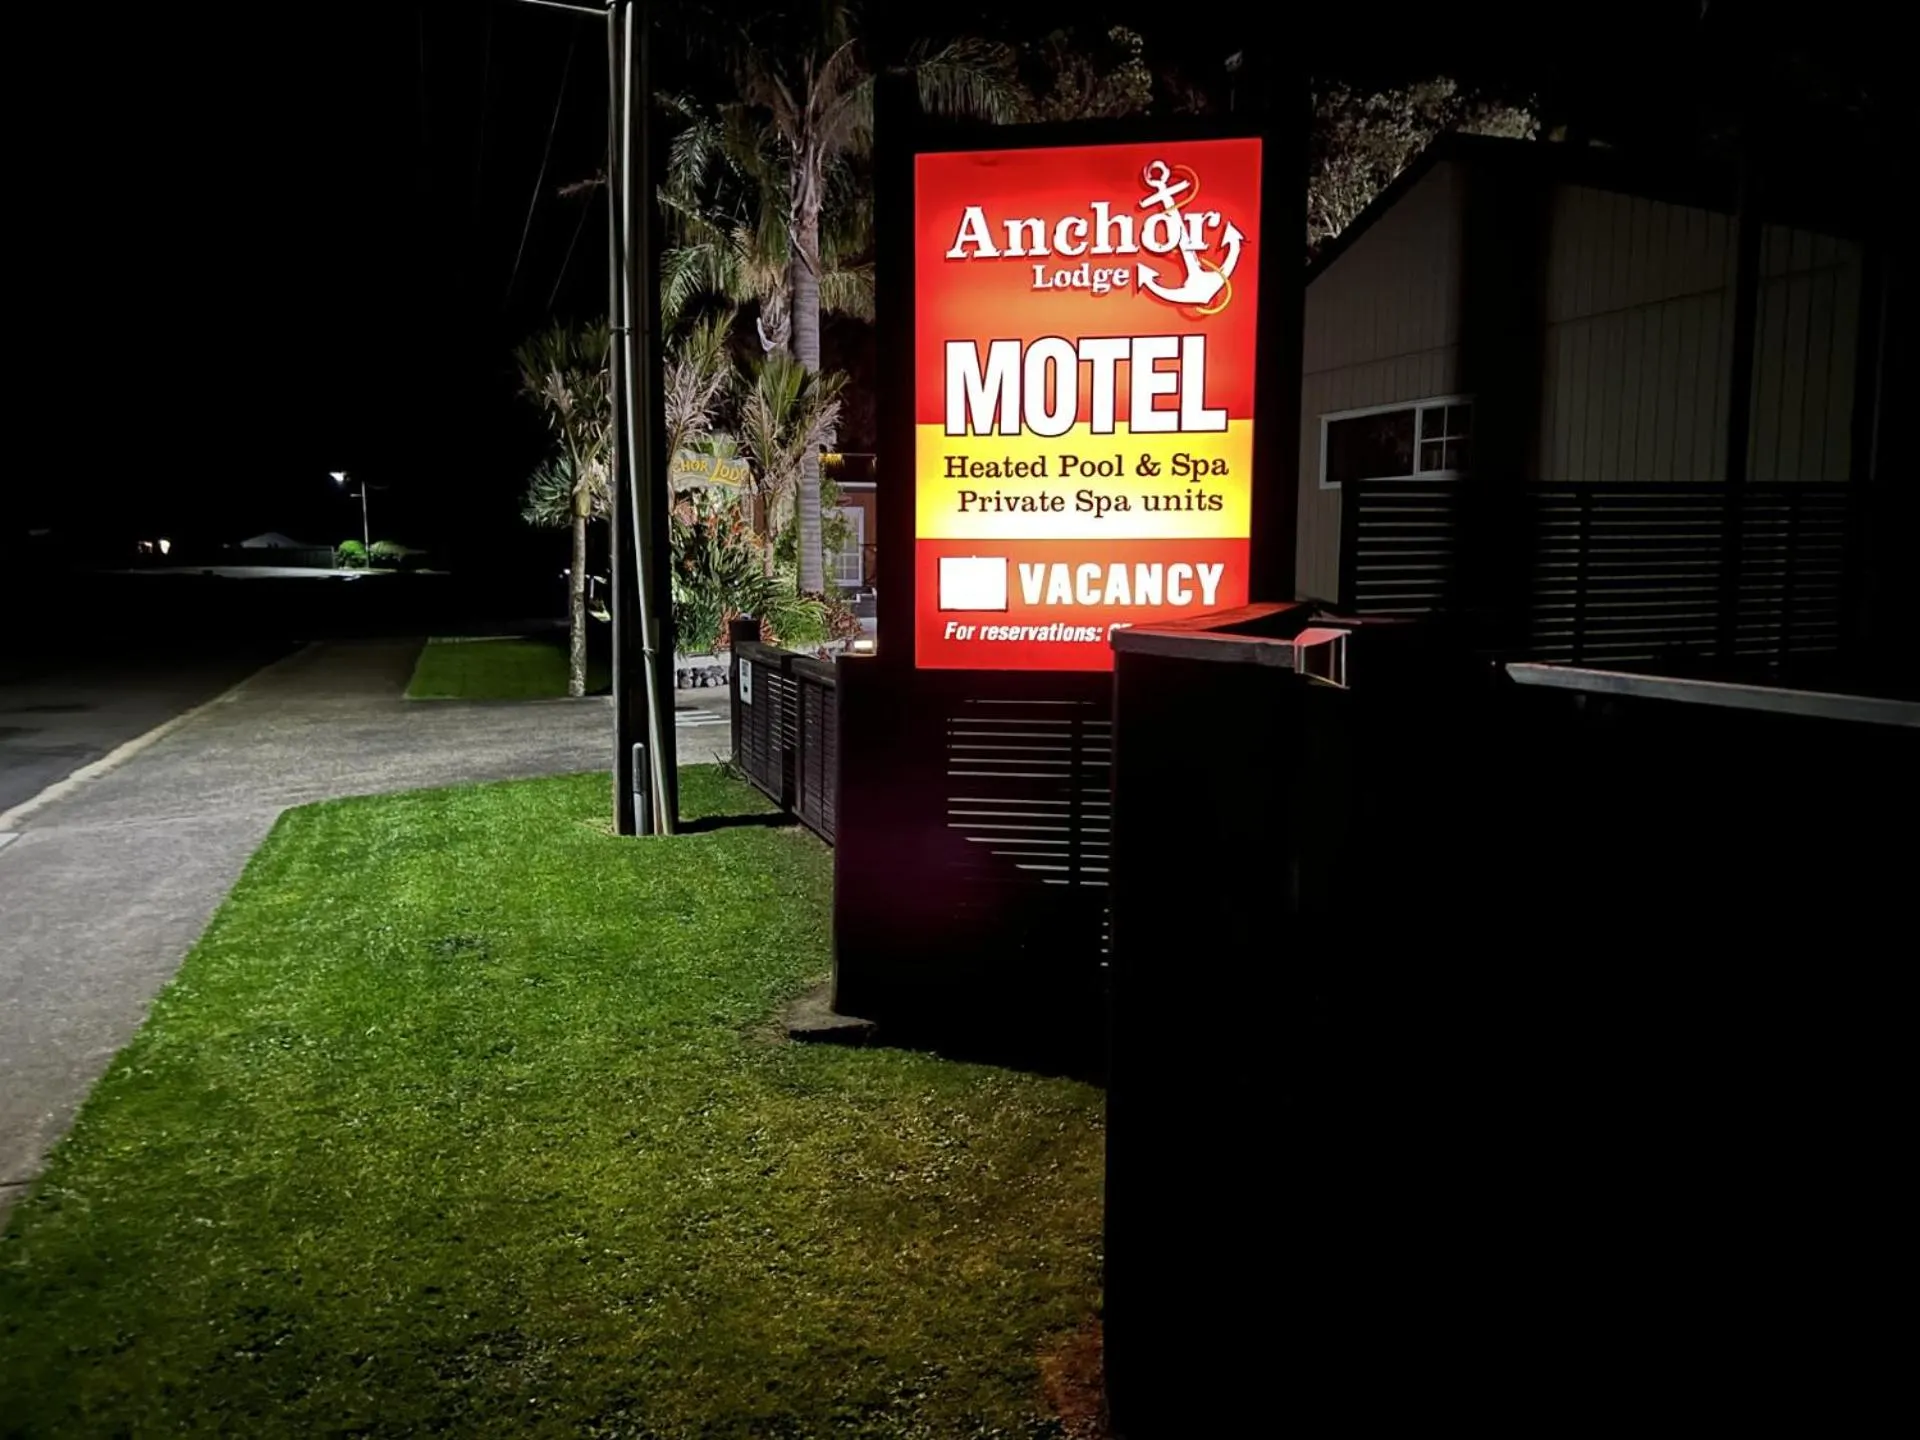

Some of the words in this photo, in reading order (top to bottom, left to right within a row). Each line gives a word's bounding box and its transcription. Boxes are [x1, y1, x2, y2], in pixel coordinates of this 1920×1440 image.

[946, 202, 1221, 258] Anchor
[1032, 263, 1130, 293] Lodge
[945, 334, 1228, 437] MOTEL
[944, 455, 1048, 478] Heated
[1058, 454, 1124, 477] Pool
[1136, 454, 1161, 476] &
[1171, 453, 1229, 482] Spa
[957, 489, 1065, 513] Private
[1075, 489, 1131, 518] Spa
[1142, 489, 1223, 512] units
[1018, 562, 1224, 606] VACANCY
[944, 622, 976, 640] For
[979, 623, 1103, 642] reservations:
